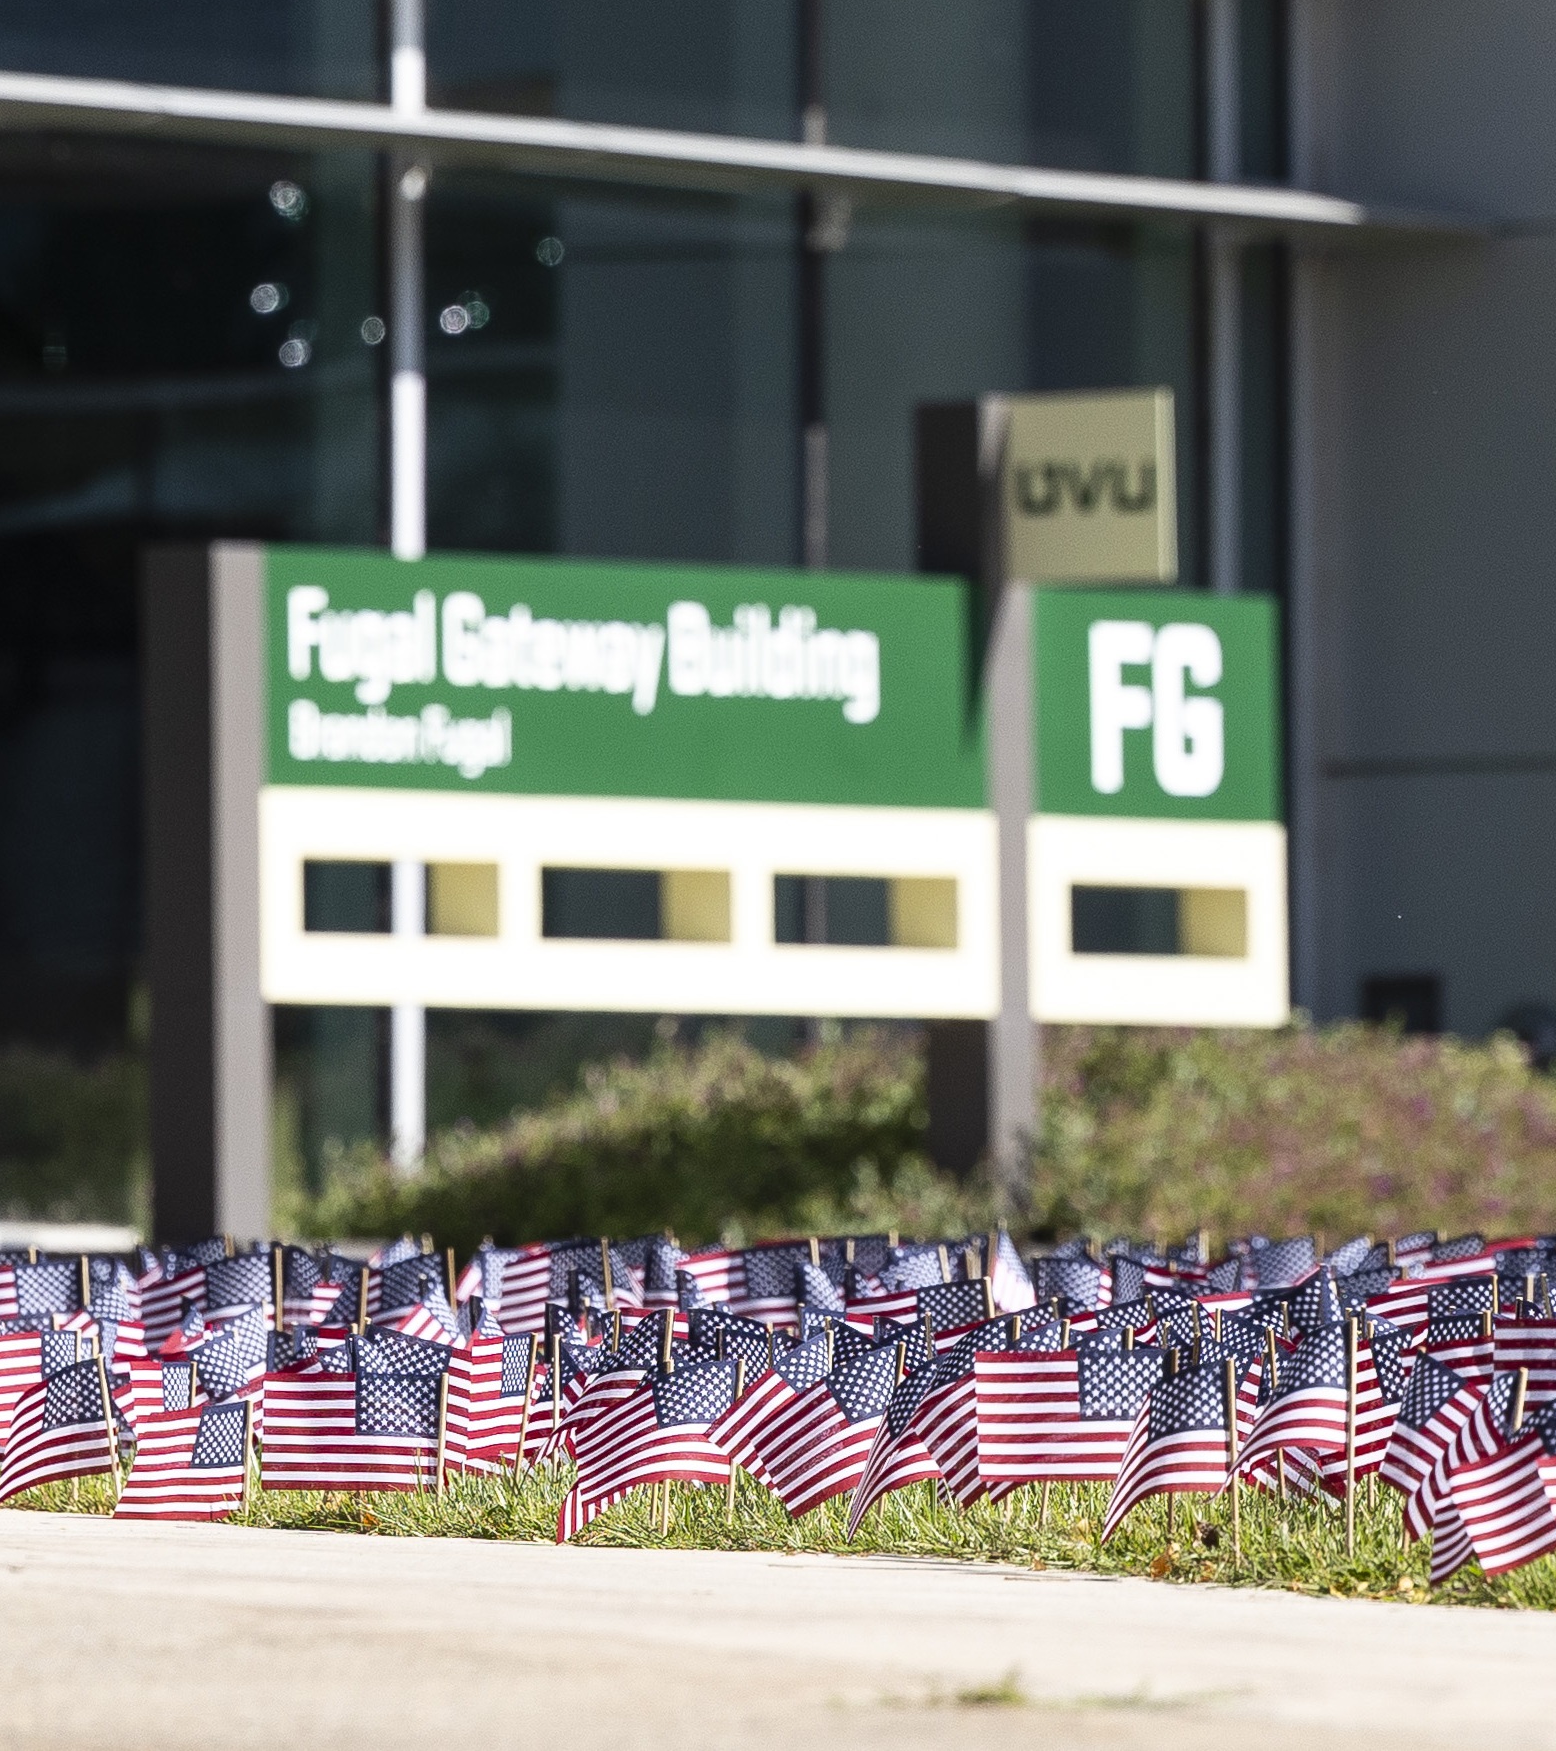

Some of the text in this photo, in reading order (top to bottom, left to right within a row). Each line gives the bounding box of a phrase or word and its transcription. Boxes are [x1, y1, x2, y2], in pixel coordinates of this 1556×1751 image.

[1016, 459, 1157, 516] UVU
[287, 585, 880, 724] Fugal Gateway Building
